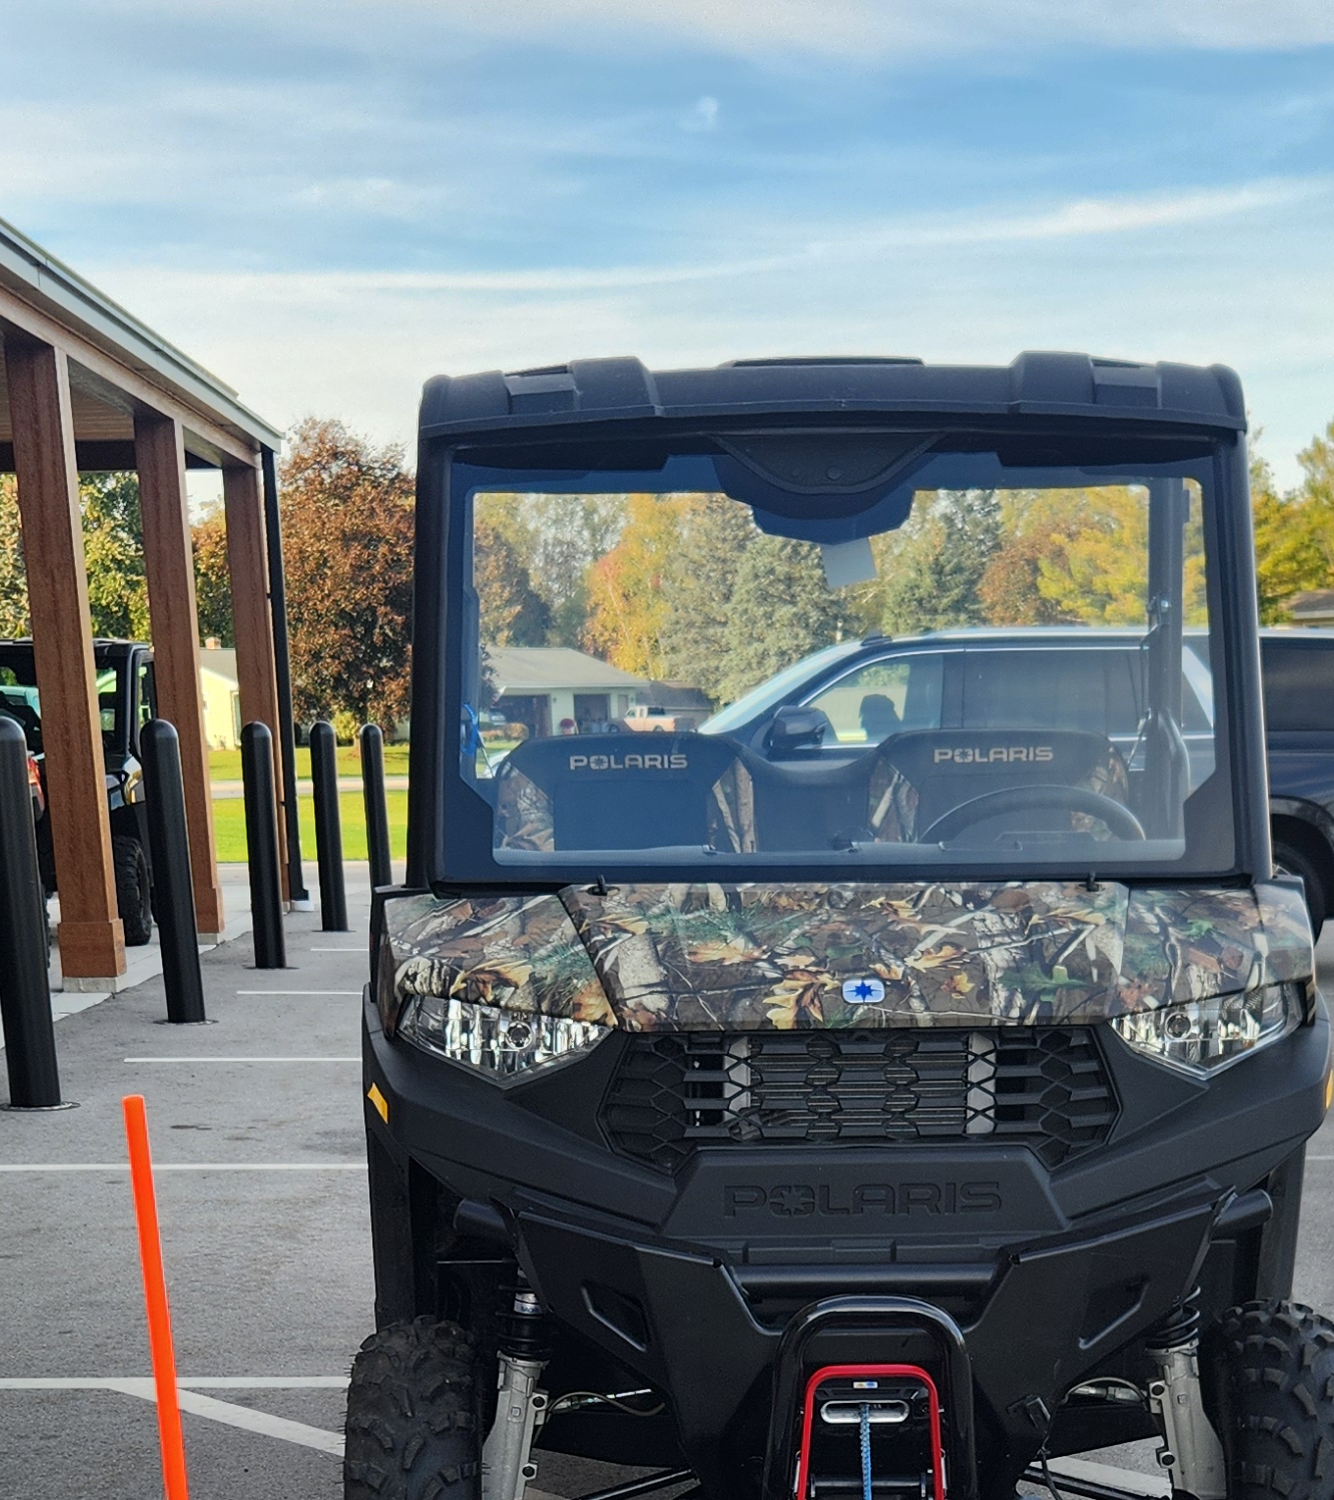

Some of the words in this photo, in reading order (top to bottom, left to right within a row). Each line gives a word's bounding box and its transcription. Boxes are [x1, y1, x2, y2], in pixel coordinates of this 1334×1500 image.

[569, 754, 688, 770] POLARIS
[933, 746, 1054, 763] POLARIS
[724, 1180, 1003, 1218] POLARIS
